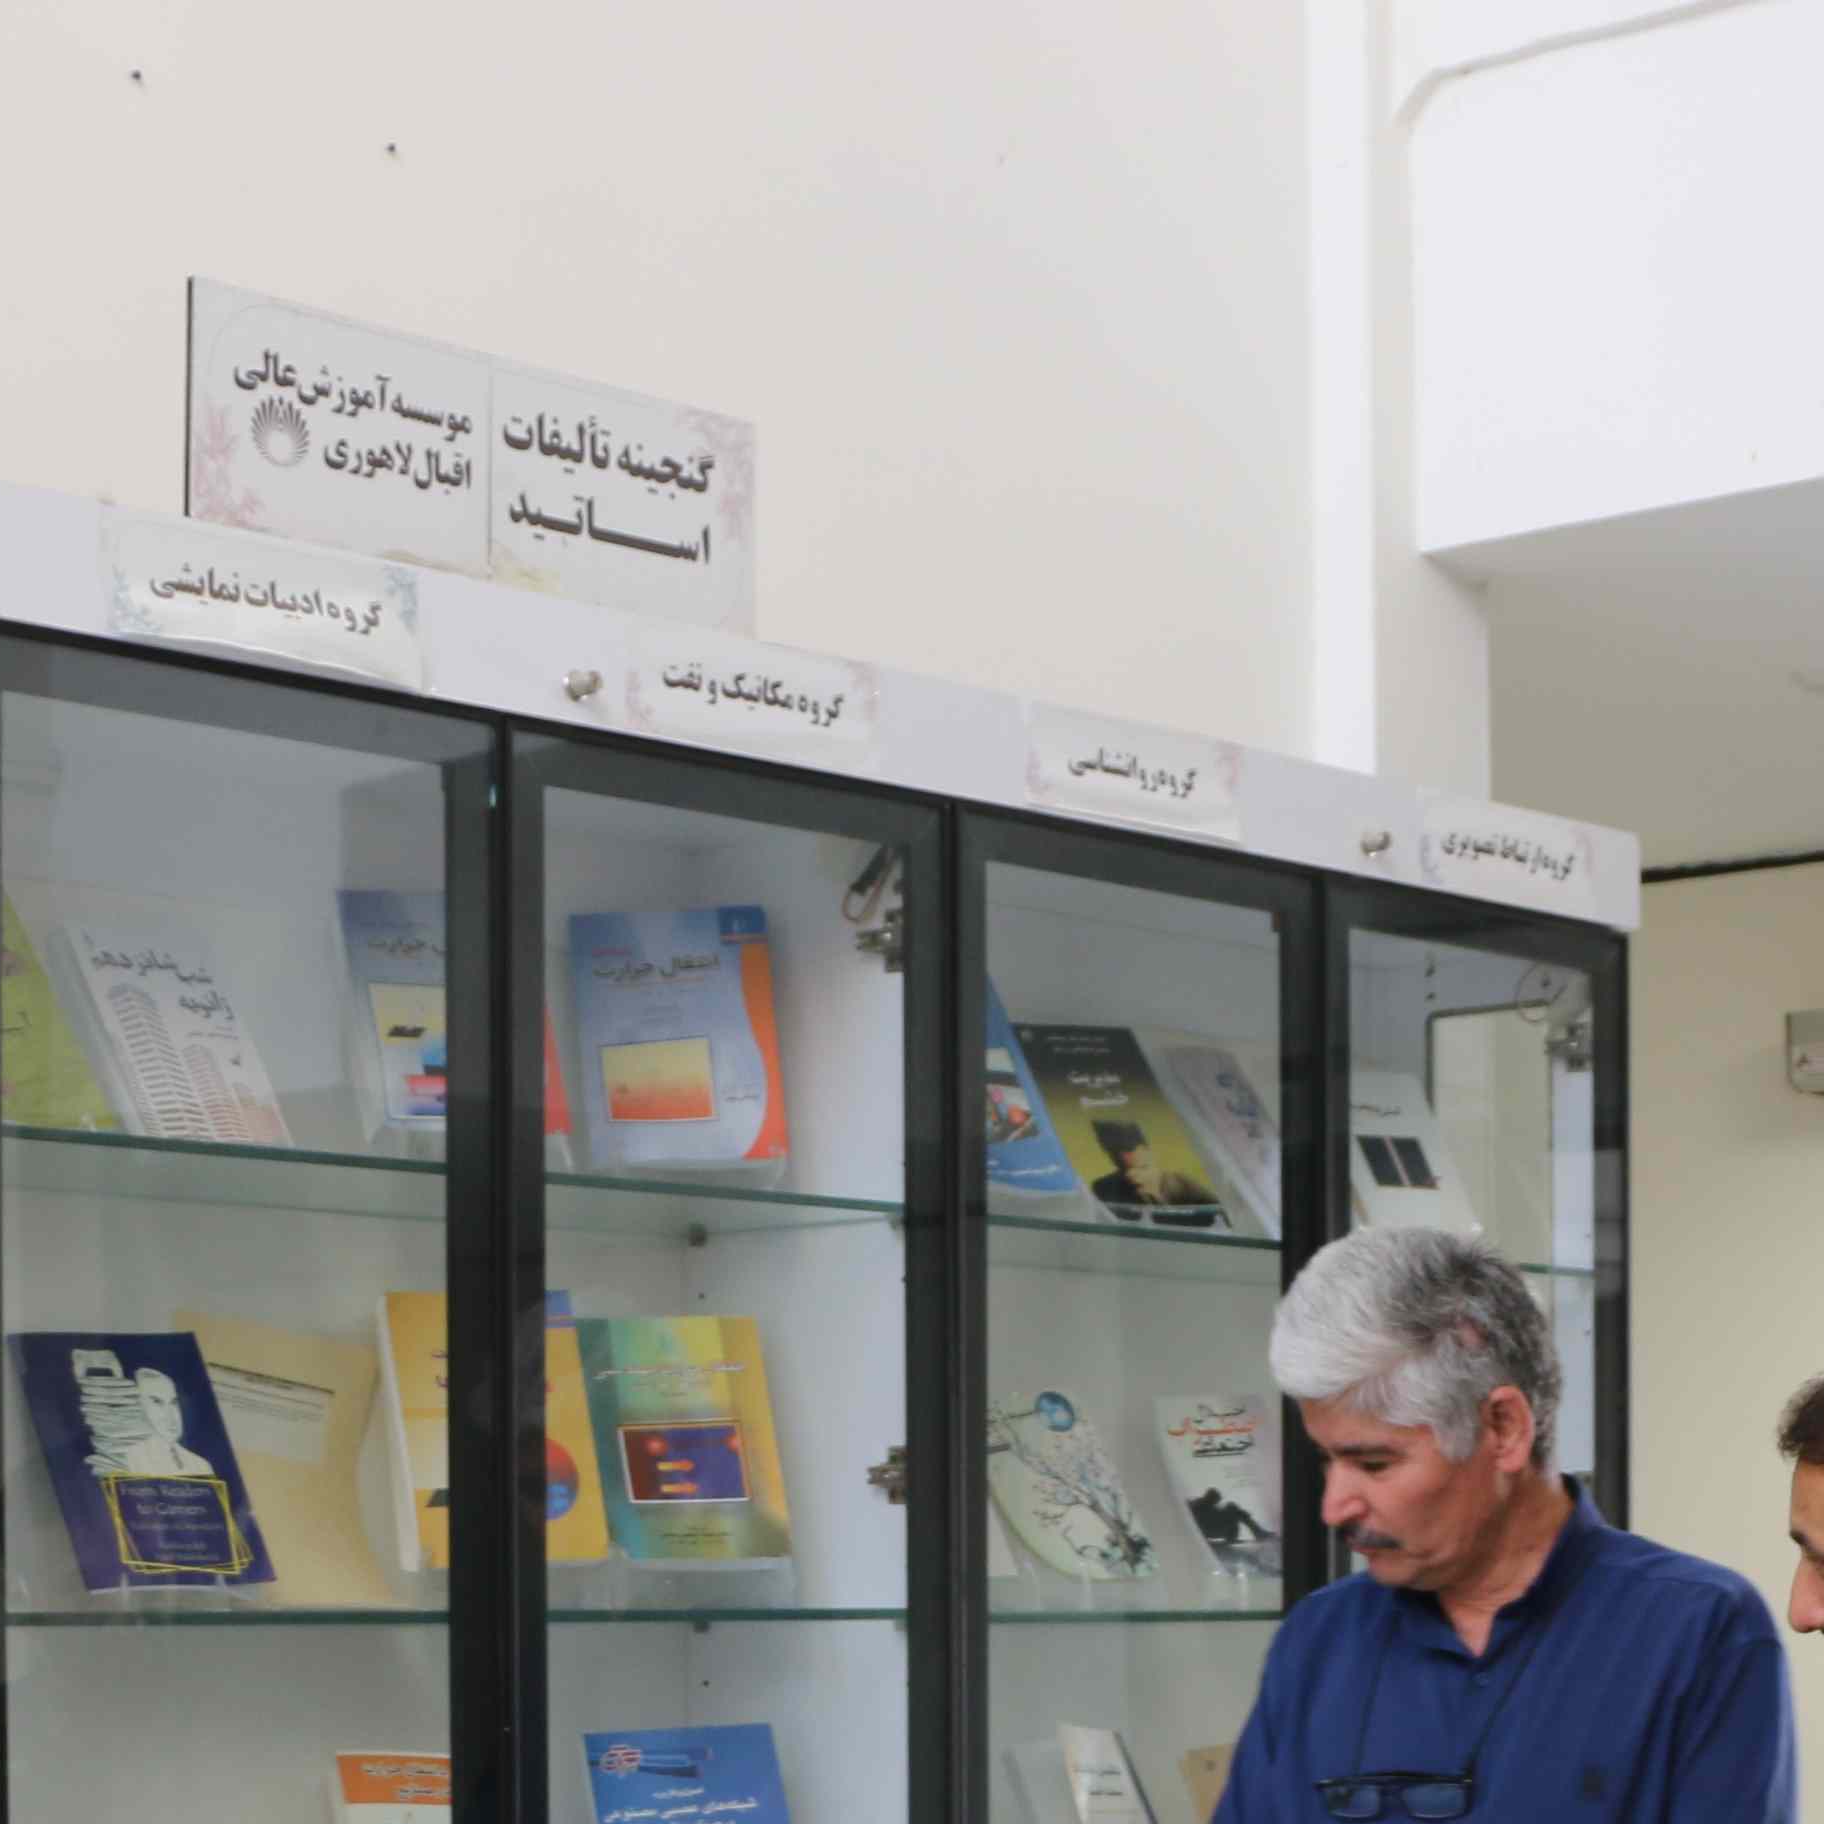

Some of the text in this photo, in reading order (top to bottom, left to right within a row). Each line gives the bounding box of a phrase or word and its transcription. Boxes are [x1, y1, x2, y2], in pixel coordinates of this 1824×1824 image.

[233, 348, 472, 441] موسسه آموزش عالی
[323, 434, 472, 497] اقبال لاهوری
[618, 440, 715, 501] گنجینه
[149, 562, 383, 636] گروه ادبیات نمایشی
[662, 662, 845, 728] گروه مکانیک و نفت
[1068, 746, 1198, 799] گروه روانشناسی
